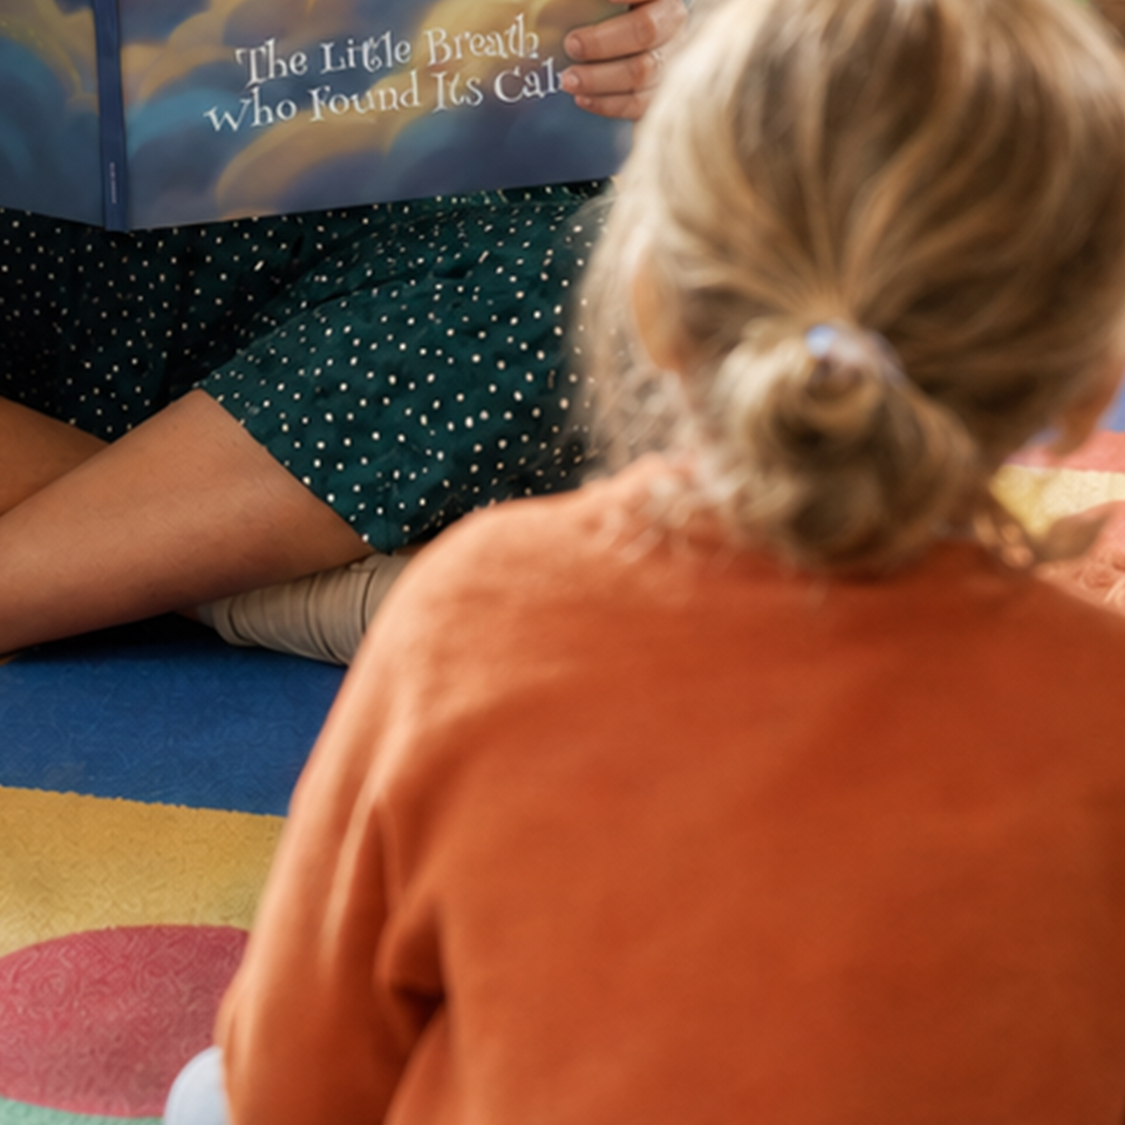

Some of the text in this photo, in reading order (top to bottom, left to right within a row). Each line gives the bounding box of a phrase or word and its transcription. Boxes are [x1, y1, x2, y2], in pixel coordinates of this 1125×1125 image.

[235, 12, 540, 90] The Little Breath
[203, 56, 563, 132] Who Found Its Cal
